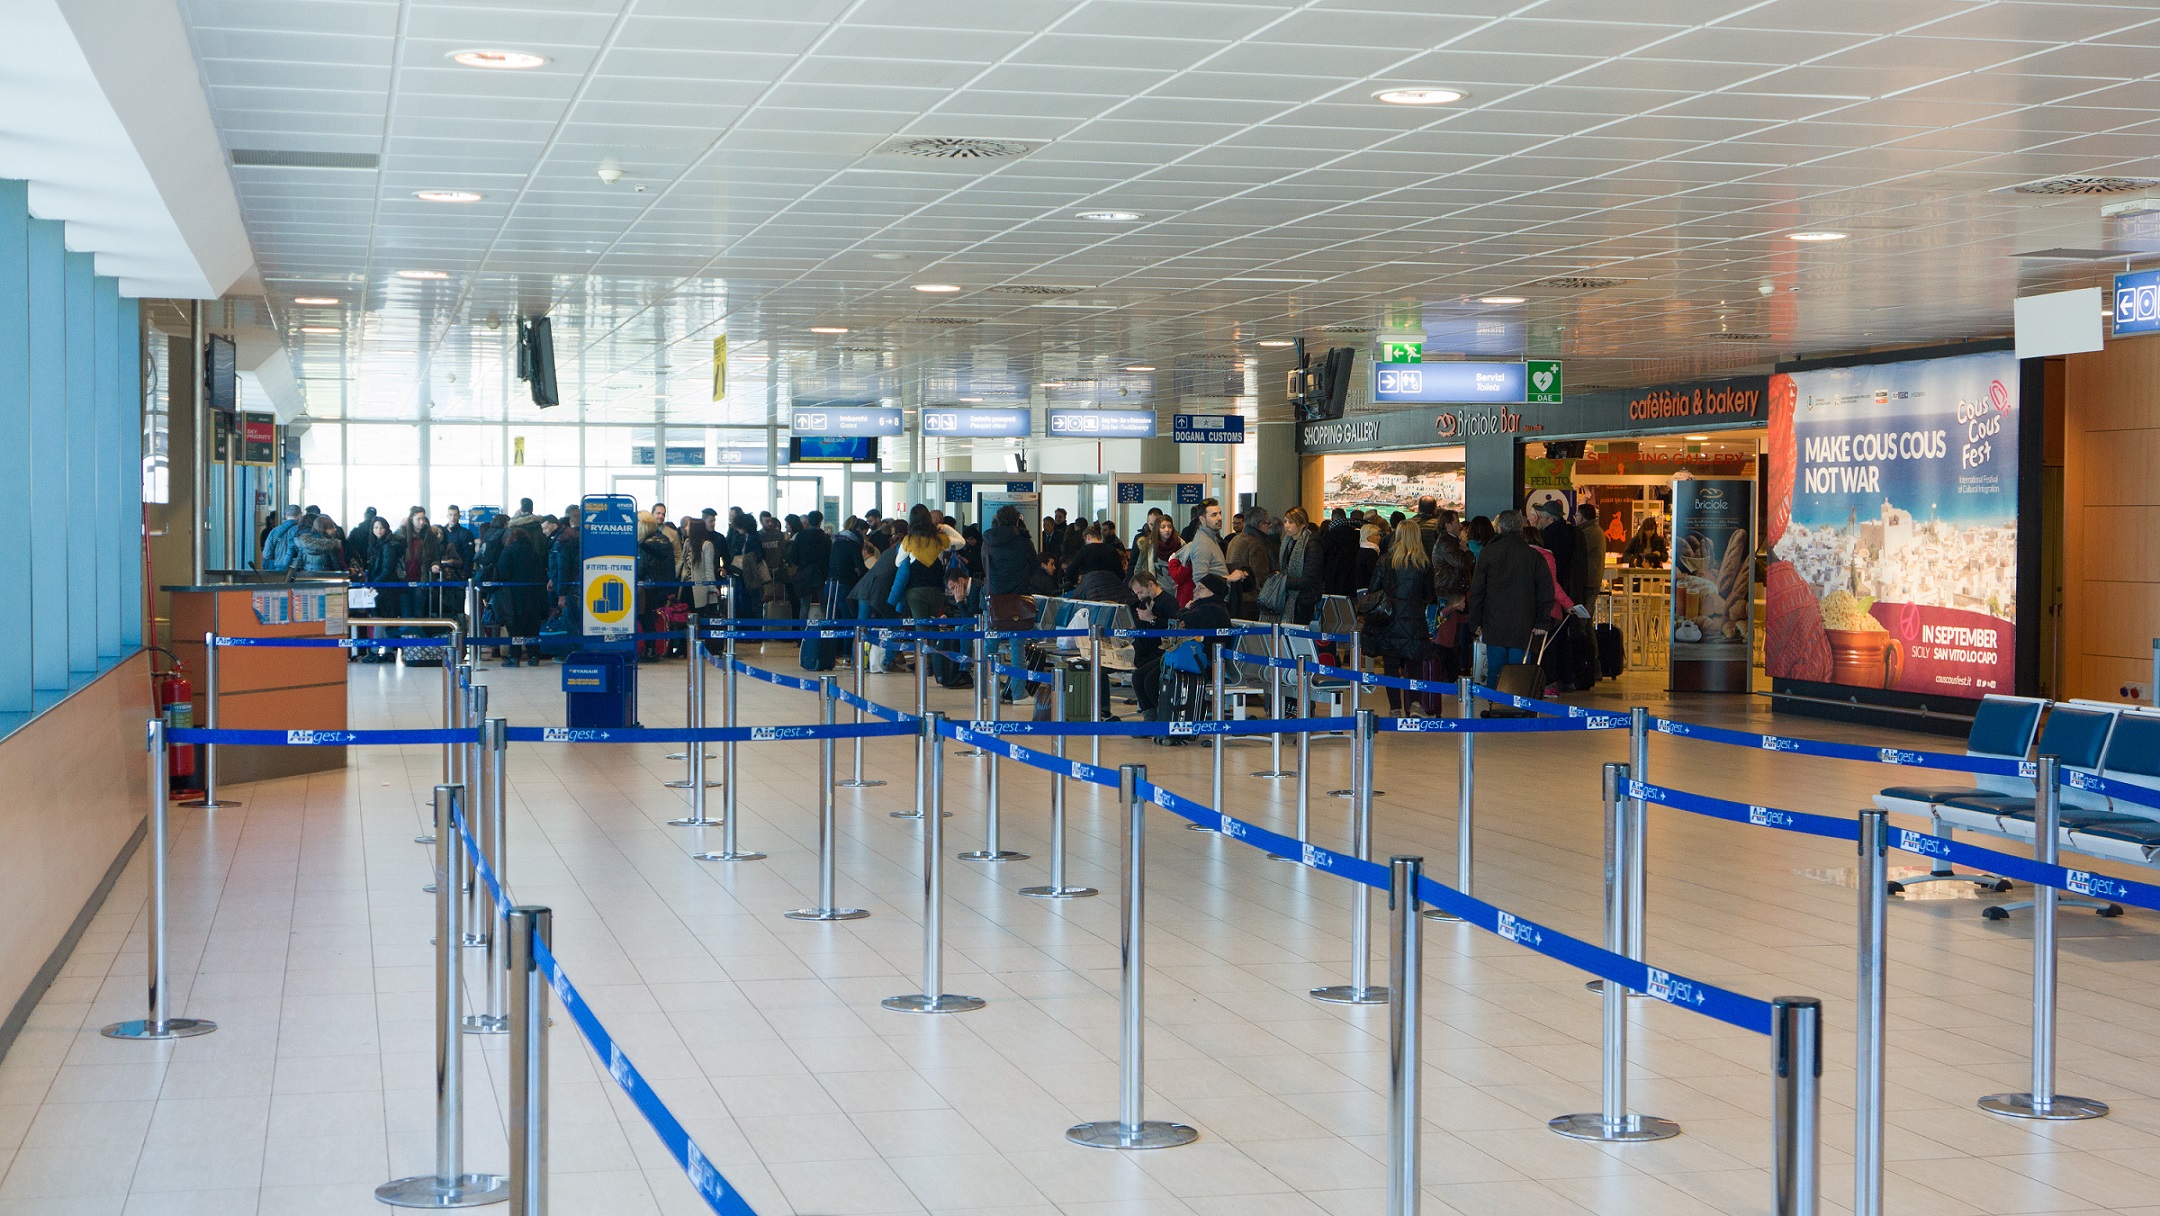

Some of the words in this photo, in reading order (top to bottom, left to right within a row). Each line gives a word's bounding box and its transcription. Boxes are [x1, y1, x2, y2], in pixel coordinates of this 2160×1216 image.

[1476, 373, 1504, 382] Servizi
[1538, 394, 1552, 402] DAE
[1693, 389, 1703, 415] &
[1706, 387, 1759, 416] bakery
[1957, 395, 1989, 424] Cous
[879, 417, 885, 426] 6
[894, 417, 900, 426] 8
[1457, 408, 1498, 436] Briciole
[1501, 406, 1521, 433] Bar
[1968, 415, 2000, 443] Cous
[1175, 431, 1205, 441] DOGANA
[1209, 432, 1243, 442] CUSTOMS
[1304, 426, 1343, 446] SHOPPING
[1343, 421, 1380, 442] GALLERY
[1805, 435, 1850, 463] MAKE
[1853, 432, 1898, 461] COUS
[1900, 430, 1947, 459] COUS
[1962, 441, 1991, 470] Fest
[1588, 452, 1668, 465] SHOPPING
[1672, 453, 1744, 465] GALLERY
[1805, 467, 1839, 494] NOT
[1841, 465, 1880, 493] WAR
[1695, 499, 1728, 509] Briciole
[590, 524, 633, 532] RYANAIR
[1923, 625, 1934, 643] IN
[1935, 626, 1997, 648] SEPTEMBER
[1912, 646, 1931, 658] SICILY
[1934, 647, 1948, 660] SAN
[1949, 649, 1966, 662] VITO
[1967, 651, 1976, 663] LO
[1977, 652, 1997, 665] CAPO
